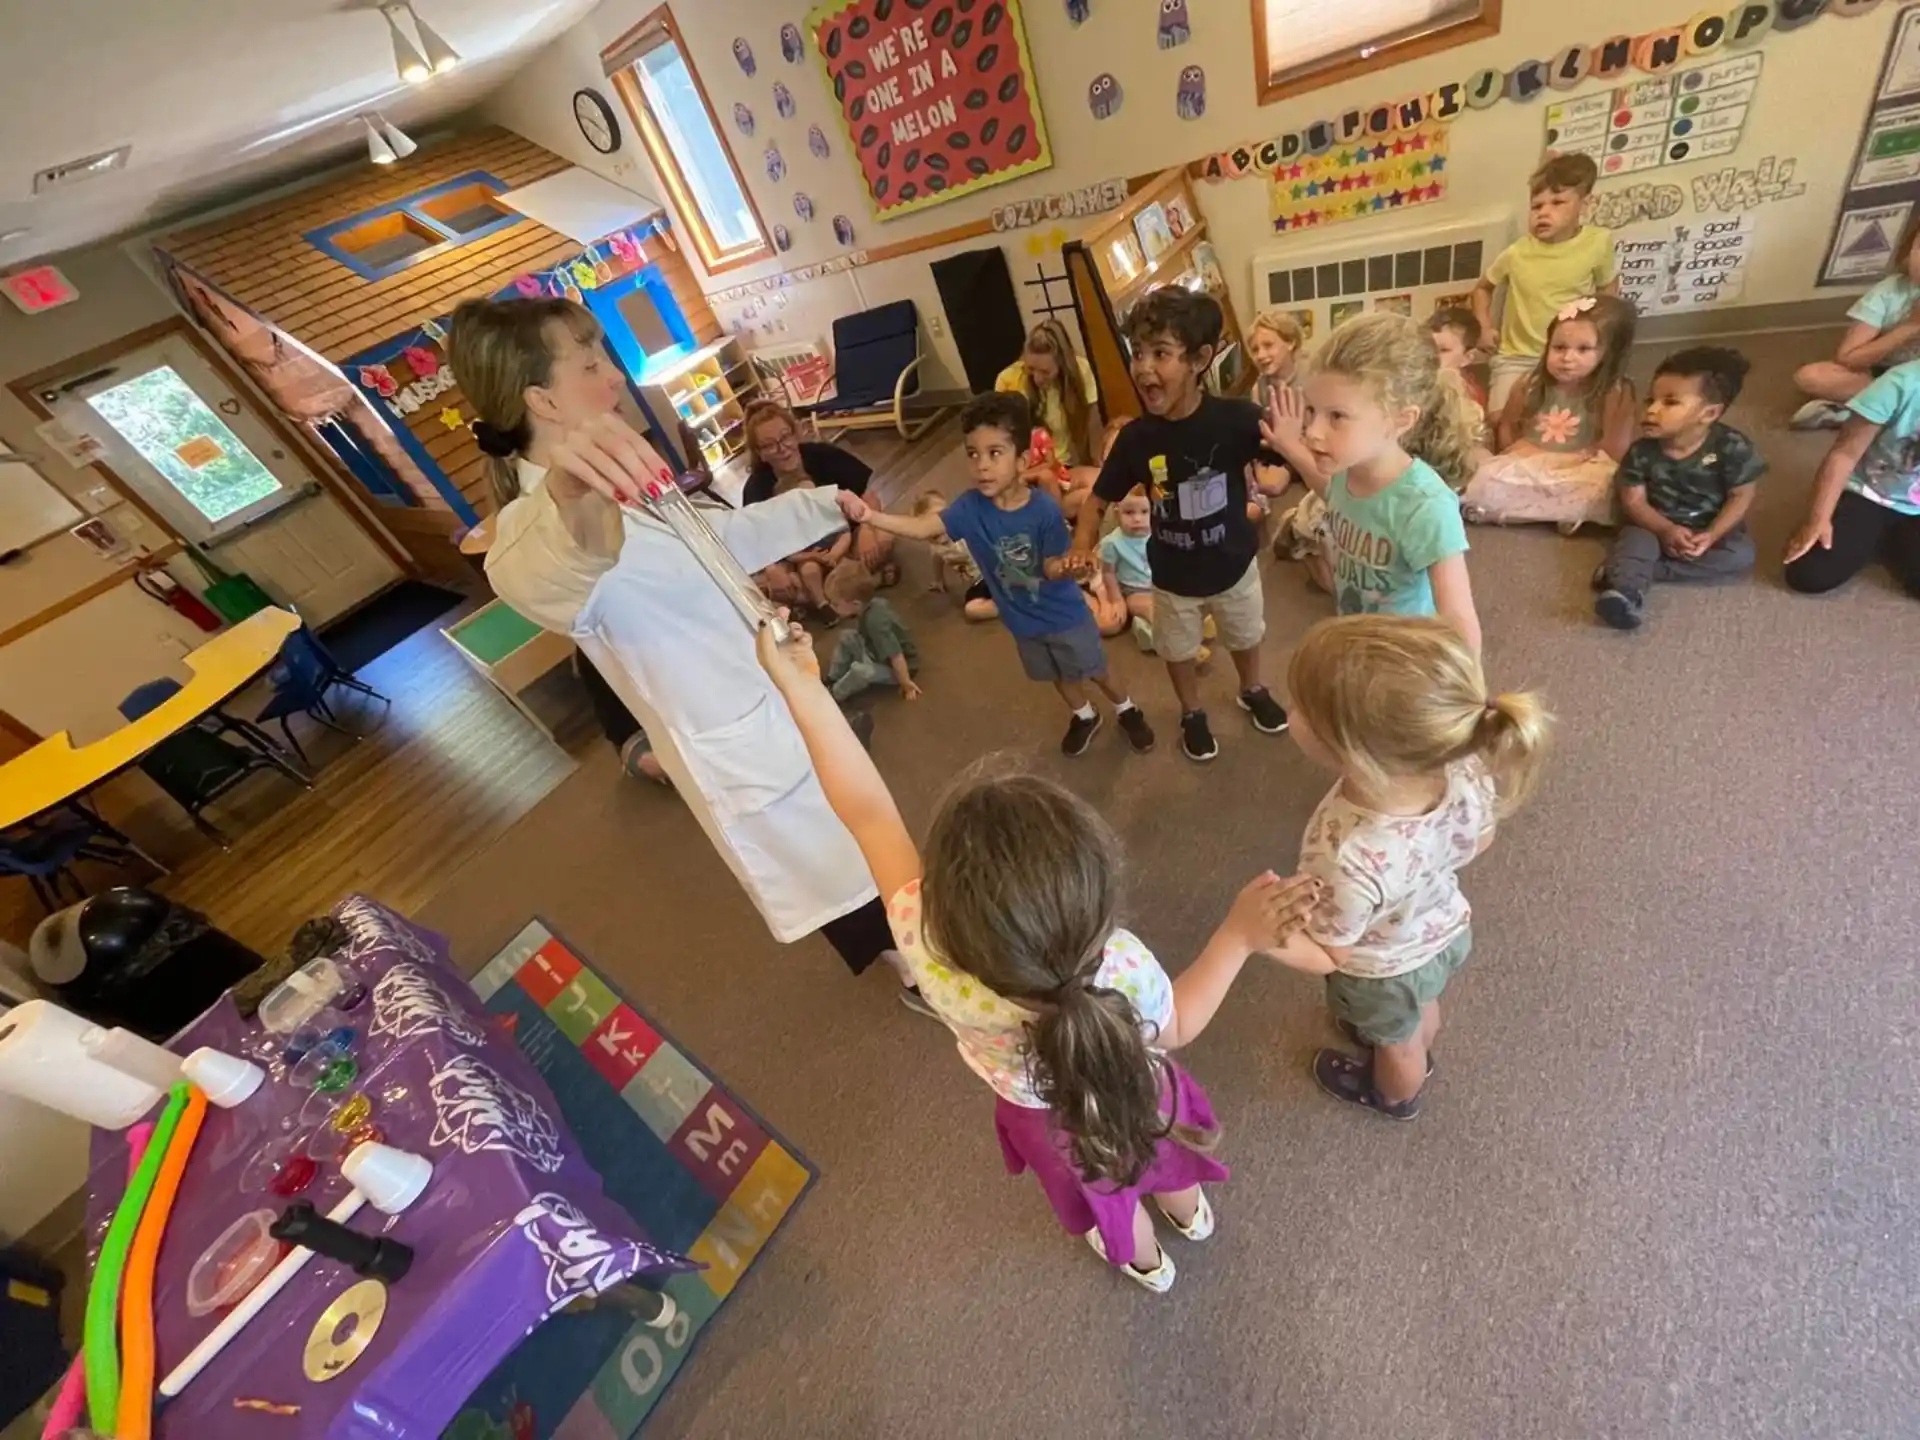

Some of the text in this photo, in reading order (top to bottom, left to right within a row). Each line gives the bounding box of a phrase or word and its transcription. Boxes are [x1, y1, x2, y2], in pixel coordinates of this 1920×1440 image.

[868, 17, 929, 73] WE'RE
[866, 48, 958, 114] ONE IN A
[890, 95, 957, 146] MELON
[1703, 217, 1741, 237] goat
[1694, 235, 1744, 255] goose
[1686, 252, 1742, 272] donkey
[1692, 270, 1729, 287] duck
[1694, 287, 1718, 302] cat
[1336, 552, 1398, 594] OALS
